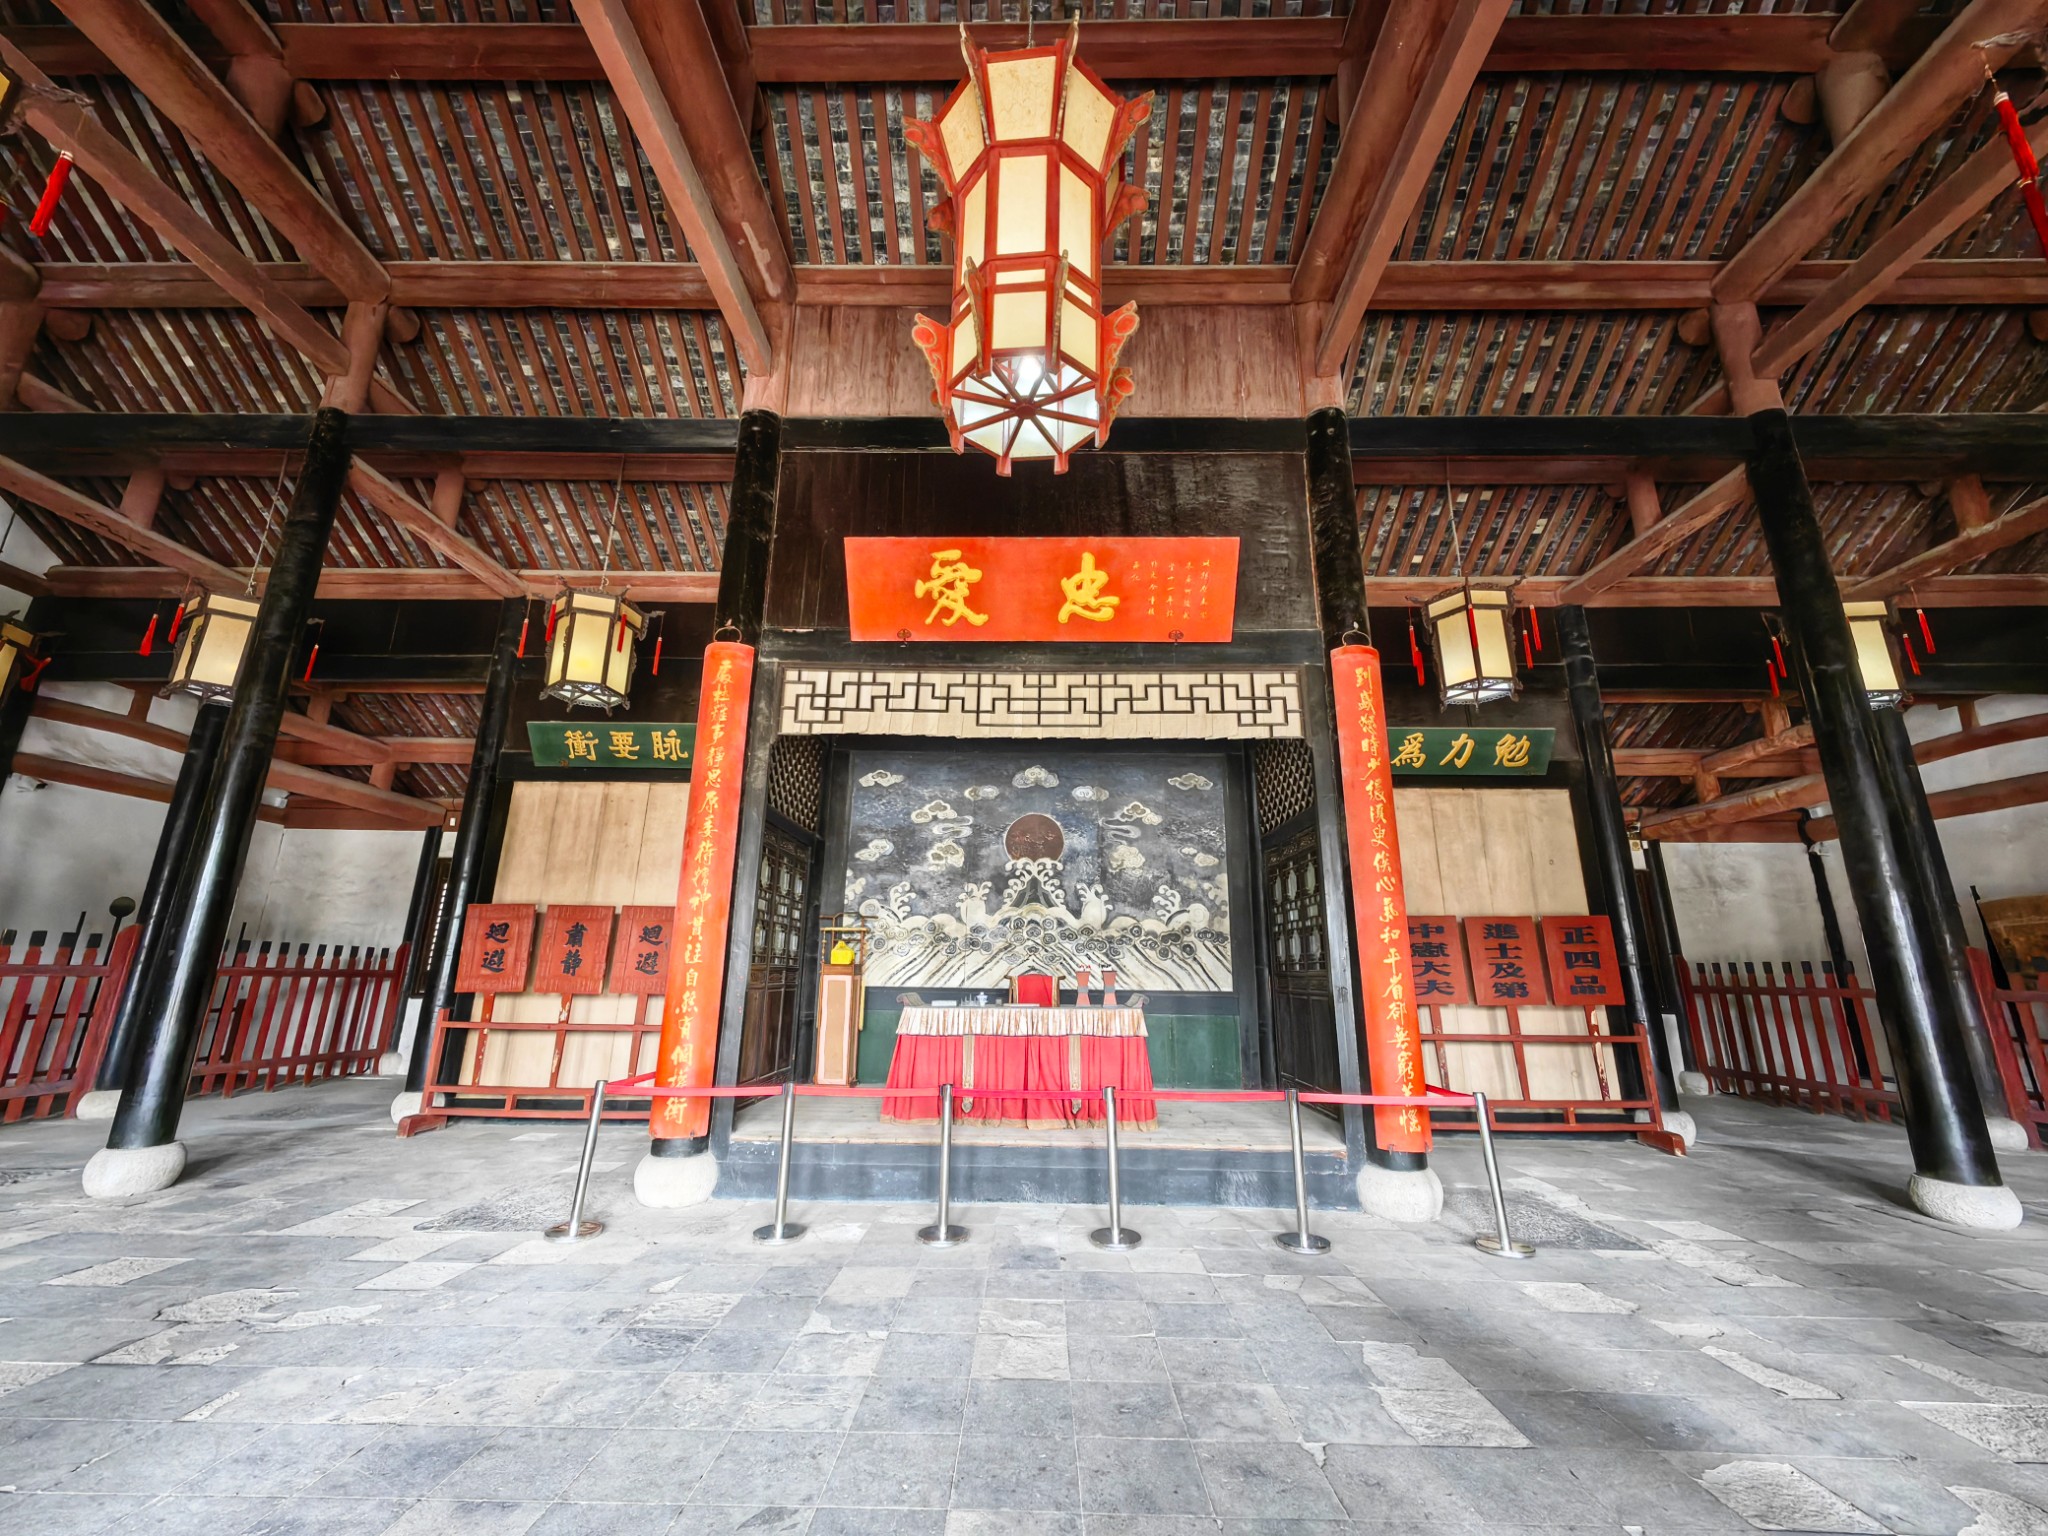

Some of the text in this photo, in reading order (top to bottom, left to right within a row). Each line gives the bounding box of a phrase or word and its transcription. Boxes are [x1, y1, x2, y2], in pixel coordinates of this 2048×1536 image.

[1408, 923, 1455, 997] 中憲大夫
[1482, 923, 1531, 999] 進士及第
[1560, 926, 1606, 995] 正四品
